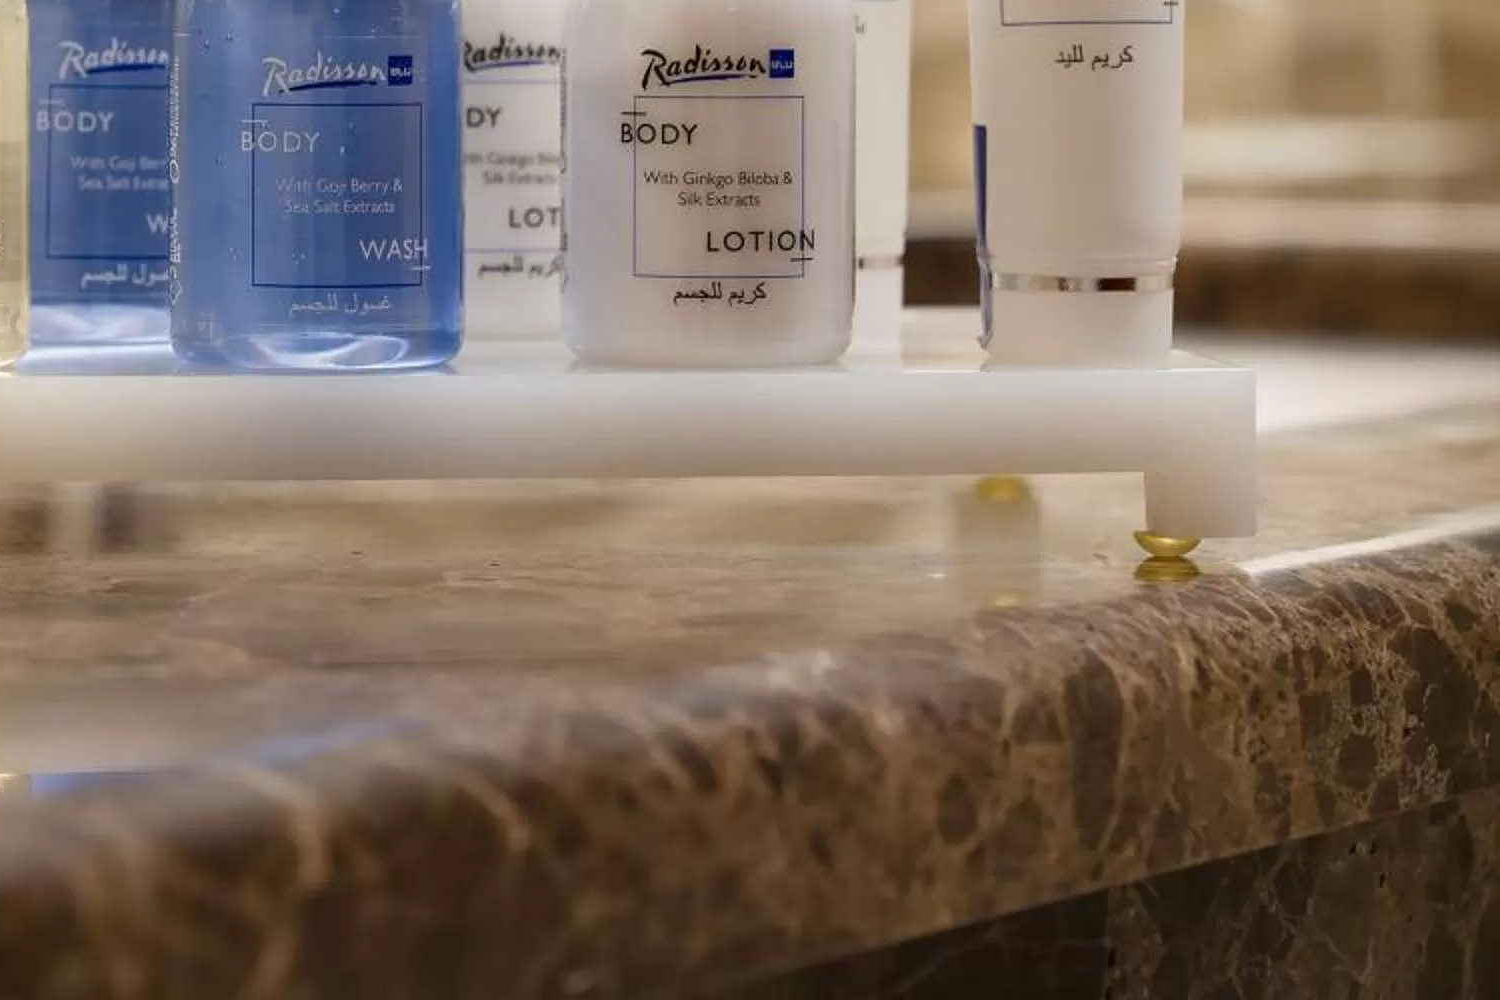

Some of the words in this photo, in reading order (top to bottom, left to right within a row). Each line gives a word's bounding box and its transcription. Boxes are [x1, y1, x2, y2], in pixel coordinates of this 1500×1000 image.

[58, 36, 169, 80] Radisson
[1055, 44, 1085, 68] لليد
[1091, 45, 1133, 70] كريم
[261, 51, 387, 97] Radisson
[641, 44, 767, 91] Radisson
[35, 110, 115, 133] BODY
[466, 107, 503, 128] DY
[240, 131, 320, 153] BODY
[620, 123, 699, 145] BODY
[275, 177, 312, 193] With
[351, 178, 389, 195] Berry
[392, 178, 403, 193] &
[643, 171, 679, 185] With
[683, 171, 734, 188] Ginkgo
[738, 171, 779, 185] Biloba
[782, 171, 793, 185] &
[283, 200, 310, 214] Sea
[343, 200, 396, 214] Extracts
[677, 191, 702, 207] Silk
[706, 192, 762, 207] Extracts
[508, 206, 561, 229] LOT
[359, 238, 429, 260] WASH
[707, 230, 815, 252] LOTION
[344, 293, 392, 315] غسول
[672, 281, 722, 306] للجسم
[727, 282, 768, 307] كريم
[288, 293, 339, 317] للجسم
